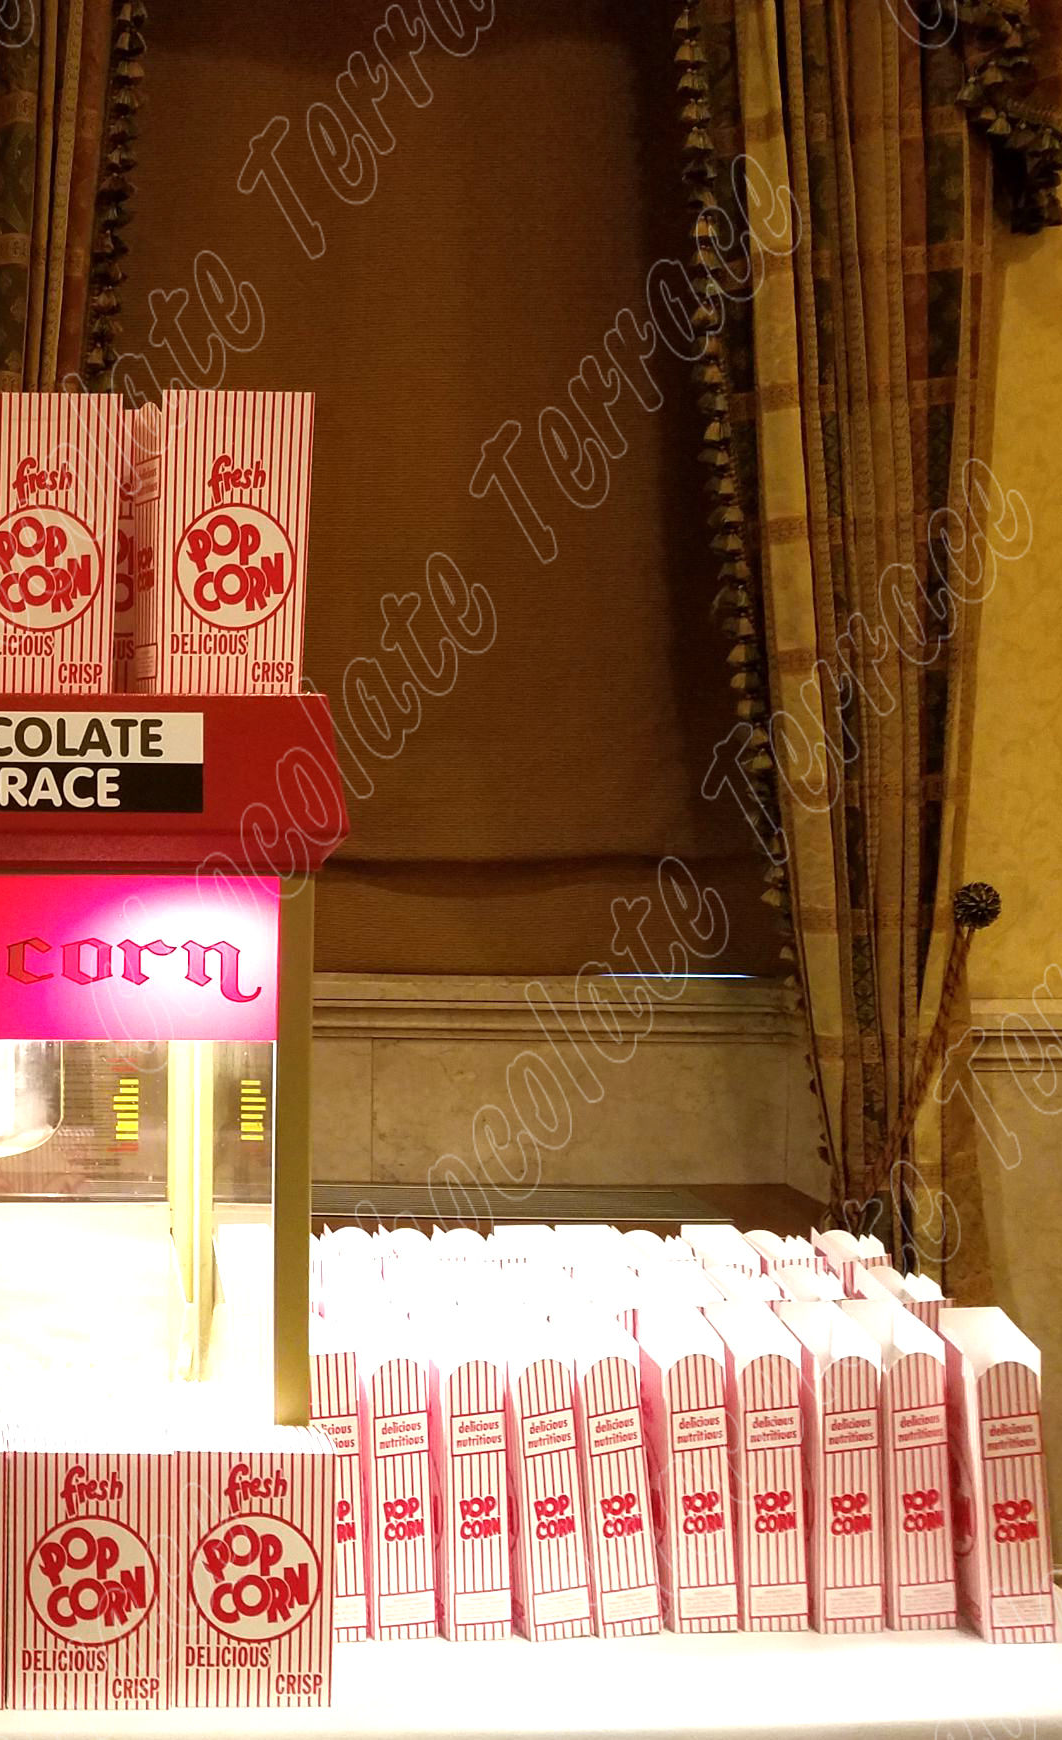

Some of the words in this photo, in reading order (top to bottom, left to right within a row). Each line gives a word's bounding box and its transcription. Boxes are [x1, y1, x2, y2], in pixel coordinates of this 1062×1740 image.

[12, 456, 73, 505] fresh
[208, 455, 266, 504] fresh
[186, 515, 260, 571] POP
[194, 552, 284, 611] CORN
[170, 633, 248, 655] DELICIOUS
[58, 663, 103, 684] CRISP
[252, 662, 294, 682] CRISP
[381, 1421, 421, 1435] delicious
[458, 1420, 499, 1434] delicious
[529, 1418, 567, 1434] delicious
[595, 1417, 634, 1433] delicious
[679, 1416, 720, 1430] delicious
[752, 1416, 794, 1429] delicious
[831, 1416, 872, 1431] delicious
[379, 1435, 424, 1450] nutritious
[456, 1433, 502, 1448] nutritious
[528, 1432, 572, 1449] nutritious
[594, 1431, 638, 1448] nutritious
[750, 1429, 797, 1443] nutritious
[61, 1465, 123, 1517] fresh
[224, 1463, 288, 1514] fresh
[383, 1497, 420, 1523] POP
[459, 1496, 496, 1521] POP
[534, 1495, 570, 1520] POP
[600, 1492, 636, 1519] POP
[682, 1491, 720, 1516] POP
[753, 1491, 793, 1514] POP
[831, 1492, 869, 1516] POP
[902, 1489, 940, 1513] POP
[384, 1518, 425, 1542] CORN
[460, 1517, 501, 1540] CORN
[536, 1516, 576, 1540] CORN
[602, 1514, 643, 1538] CORN
[683, 1512, 725, 1535] CORN
[755, 1512, 797, 1533] CORN
[39, 1527, 119, 1587] POP
[202, 1524, 282, 1581] POP
[47, 1566, 145, 1627] CORN
[210, 1563, 309, 1623] CORN
[22, 1650, 107, 1671] DELICIOUS
[186, 1646, 270, 1668] DELICIOUS
[112, 1678, 160, 1699] CRISP
[275, 1674, 323, 1695] CRISP
